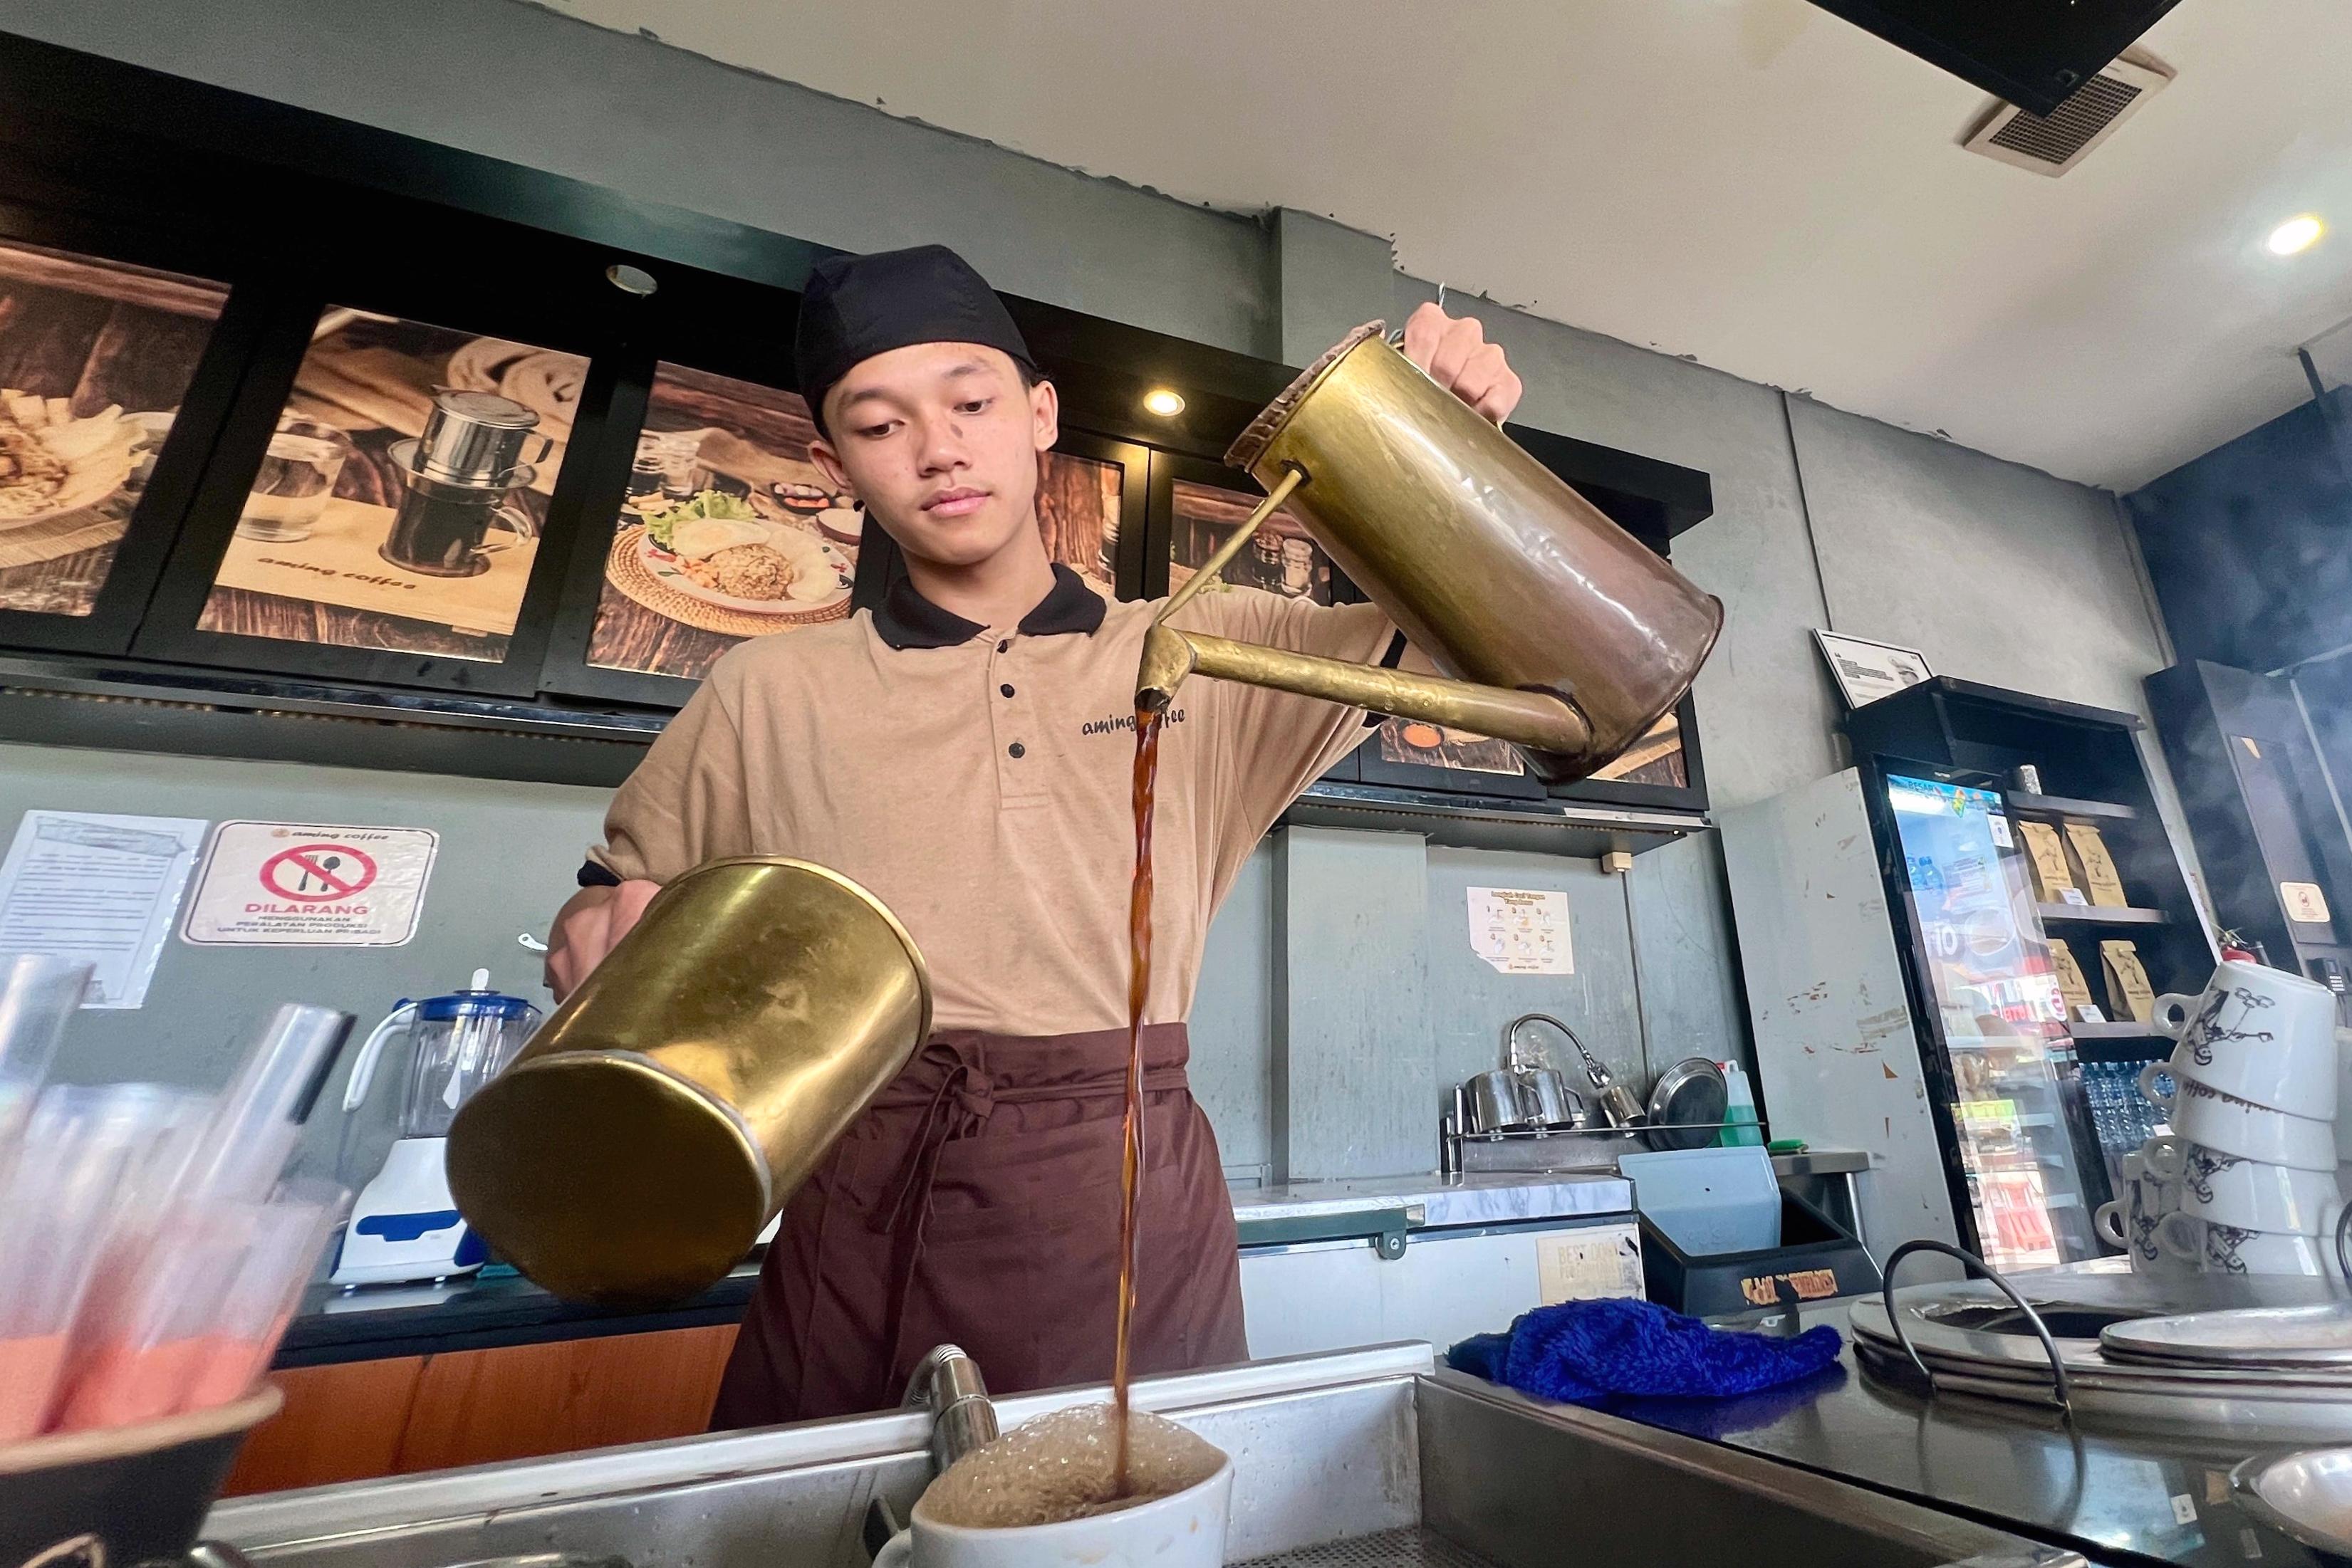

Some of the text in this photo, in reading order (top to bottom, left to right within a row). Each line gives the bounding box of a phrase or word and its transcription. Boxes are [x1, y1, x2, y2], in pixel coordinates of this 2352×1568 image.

[257, 558, 416, 590] aming coffee
[1082, 714, 1136, 735] aming
[291, 830, 390, 841] aming coffee
[244, 903, 369, 915] DILARANG
